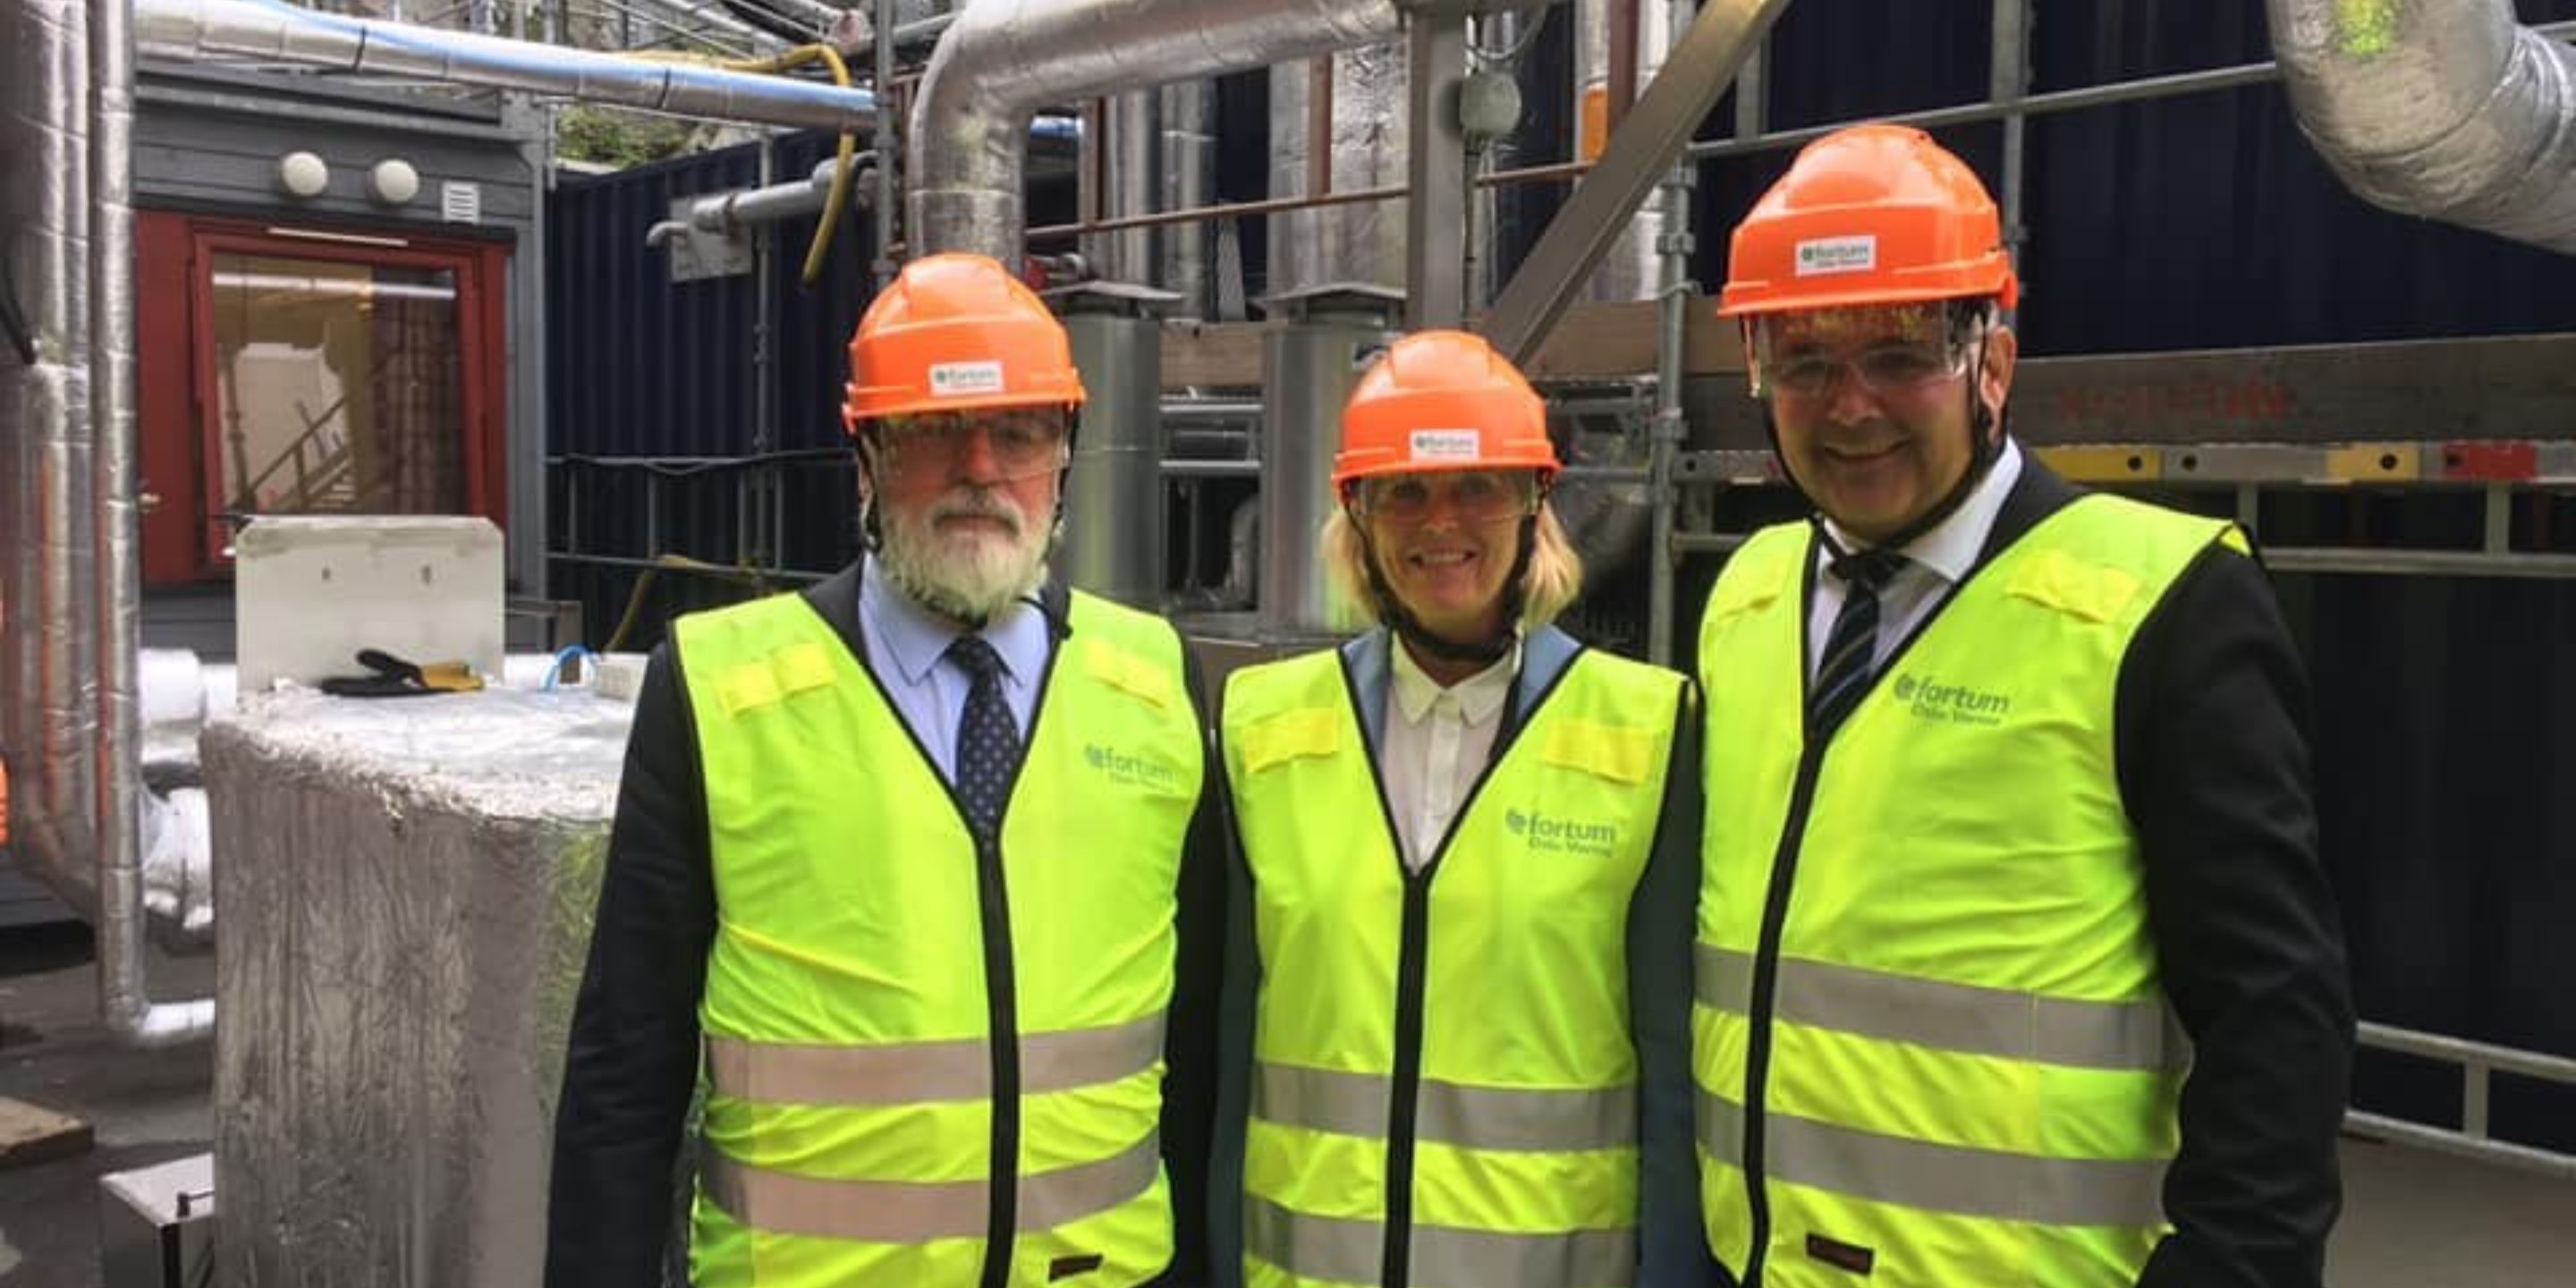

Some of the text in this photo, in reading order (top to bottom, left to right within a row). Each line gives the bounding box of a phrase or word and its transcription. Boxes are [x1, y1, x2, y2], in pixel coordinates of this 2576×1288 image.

[1917, 674, 2009, 713] fortum
[1105, 744, 1175, 784] fortum
[1530, 810, 1616, 844] fortum
